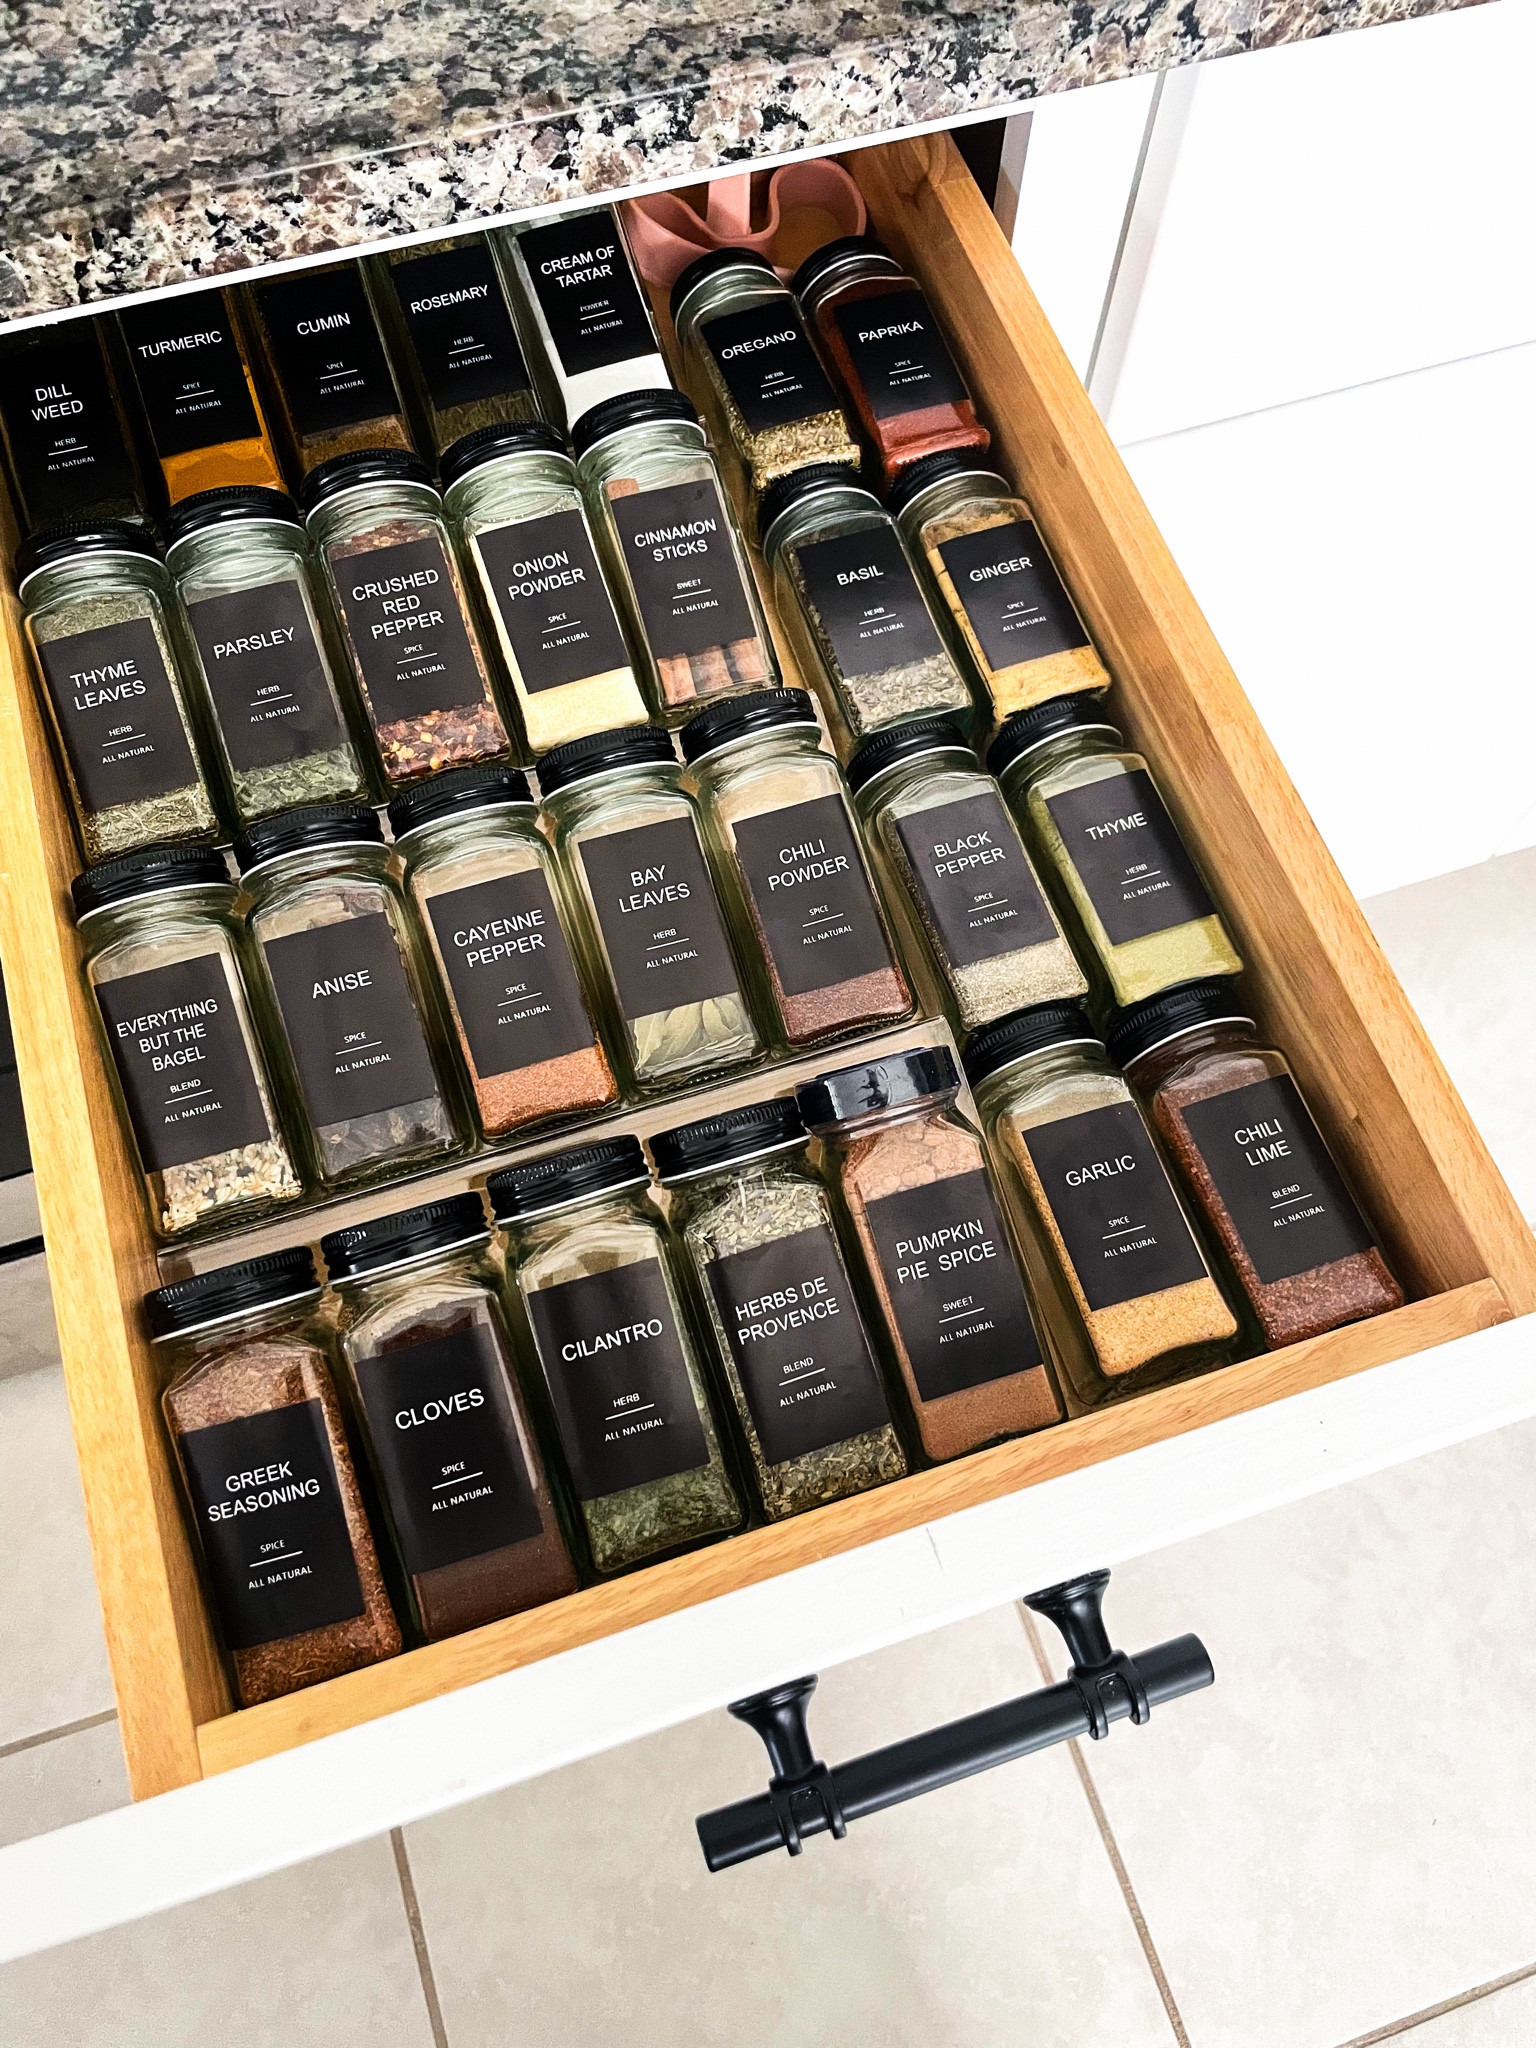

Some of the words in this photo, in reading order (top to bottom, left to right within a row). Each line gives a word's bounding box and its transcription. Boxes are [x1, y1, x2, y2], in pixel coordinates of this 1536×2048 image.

[540, 250, 594, 274] CREAM
[596, 245, 615, 260] OF
[555, 264, 613, 288] TARTAR
[410, 284, 488, 314] ROSEMARY
[580, 300, 609, 312] POWDER
[297, 312, 350, 335] CUMIN
[593, 319, 623, 331] NATURAL
[858, 321, 924, 343] PAPRIKA
[138, 330, 222, 358] TURMERIC
[454, 336, 474, 346] HERB
[722, 330, 796, 359] OREGANO
[326, 362, 344, 370] SPICE
[462, 354, 492, 365] NATURAL
[182, 382, 200, 390] SPICE
[333, 379, 365, 391] NATURAL
[765, 371, 784, 380] HERB
[902, 373, 931, 383] NATURAL
[35, 384, 72, 402] DILL
[774, 384, 803, 395] NATURAL
[31, 400, 83, 421] WEED
[175, 407, 187, 415] ALL
[189, 400, 222, 411] NATURAL
[54, 437, 76, 447] HERB
[62, 456, 95, 467] NATURAL
[634, 518, 717, 547] CINNAMON
[653, 539, 708, 562] STICKS
[512, 550, 569, 578] ONION
[970, 557, 1033, 582] GINGER
[352, 569, 439, 601] CRUSHED
[508, 568, 586, 600] POWDER
[676, 578, 701, 590] SWEET
[836, 565, 884, 586] BASIL
[382, 595, 420, 616] RED
[672, 607, 685, 616] ALL
[686, 600, 719, 612] NATURAL
[864, 607, 885, 617] HERB
[1006, 601, 1024, 610] SPICE
[371, 610, 444, 640] PEPPER
[548, 612, 567, 624] SPICE
[872, 622, 905, 635] NATURAL
[1003, 624, 1014, 632] ALL
[1016, 616, 1046, 628] NATURAL
[213, 626, 294, 659] PARSLEY
[404, 644, 423, 654] SPICE
[542, 641, 555, 650] ALL
[556, 632, 590, 646] NATURAL
[70, 660, 138, 688] THYME
[397, 672, 410, 681] ALL
[411, 664, 446, 677] NATURAL
[74, 680, 146, 710] LEAVES
[256, 685, 280, 696] HERB
[250, 714, 264, 722] ALL
[265, 705, 300, 718] NATURAL
[108, 725, 133, 736] HERB
[102, 755, 116, 764] ALL
[118, 745, 155, 760] NATURAL
[1085, 812, 1147, 840] THYME
[779, 839, 826, 864] CHILI
[934, 831, 992, 858] BLACK
[768, 856, 850, 891] POWDER
[934, 848, 1006, 878] PEPPER
[1125, 864, 1148, 875] HERB
[630, 864, 665, 887] BAY
[618, 883, 690, 913] LEAVES
[974, 892, 994, 903] SPICE
[1123, 892, 1136, 900] ALL
[1137, 880, 1171, 896] NATURAL
[809, 904, 829, 916] SPICE
[970, 920, 983, 928] ALL
[983, 909, 1018, 924] NATURAL
[454, 909, 546, 947] CAYENNE
[653, 928, 677, 940] HERB
[803, 936, 816, 945] ALL
[817, 925, 852, 940] NATURAL
[466, 934, 546, 968] PEPPER
[646, 960, 660, 969] ALL
[662, 950, 698, 964] NATURAL
[312, 970, 372, 999] ANISE
[505, 983, 527, 995] SPICE
[116, 998, 218, 1038] EVERYTHING
[498, 1016, 513, 1025] ALL
[514, 1004, 552, 1020] NATURAL
[139, 1032, 170, 1053] BUT
[172, 1023, 207, 1043] THE
[344, 1031, 366, 1044] SPICE
[152, 1046, 206, 1071] BAGEL
[335, 1064, 350, 1074] ALL
[352, 1054, 392, 1069] NATURAL
[170, 1079, 201, 1094] BLEND
[164, 1114, 179, 1123] ALL
[182, 1102, 222, 1118] NATURAL
[1234, 1118, 1283, 1145] CHILI
[1245, 1140, 1292, 1166] LIME
[1066, 1155, 1136, 1186] GARLIC
[1272, 1184, 1300, 1199] BLEND
[1108, 1216, 1130, 1228] SPICE
[1274, 1218, 1288, 1228] ALL
[1288, 1205, 1325, 1222] NATURAL
[896, 1219, 984, 1259] PUMPKIN
[1104, 1248, 1118, 1258] ALL
[1119, 1237, 1157, 1253] NATURAL
[896, 1260, 930, 1284] PIE
[938, 1240, 996, 1271] SPICE
[735, 1287, 798, 1321] HERBS
[801, 1276, 828, 1298] DE
[942, 1296, 973, 1312] SWEET
[738, 1297, 840, 1345] PROVENCE
[562, 1318, 663, 1361] CILANTRO
[940, 1333, 954, 1344] ALL
[956, 1320, 994, 1338] NATURAL
[783, 1357, 814, 1374] BLEND
[613, 1393, 640, 1408] HERB
[780, 1396, 795, 1407] ALL
[796, 1381, 836, 1401] NATURAL
[395, 1388, 484, 1430] CLOVES
[605, 1431, 620, 1442] ALL
[622, 1418, 664, 1436] NATURAL
[226, 1461, 293, 1492] GREEK
[441, 1461, 465, 1476] SPICE
[208, 1478, 320, 1522] SEASONING
[432, 1500, 448, 1512] ALL
[450, 1486, 493, 1506] NATURAL
[260, 1540, 285, 1553] SPICE
[248, 1578, 265, 1589] ALL
[267, 1566, 312, 1584] NATURAL
